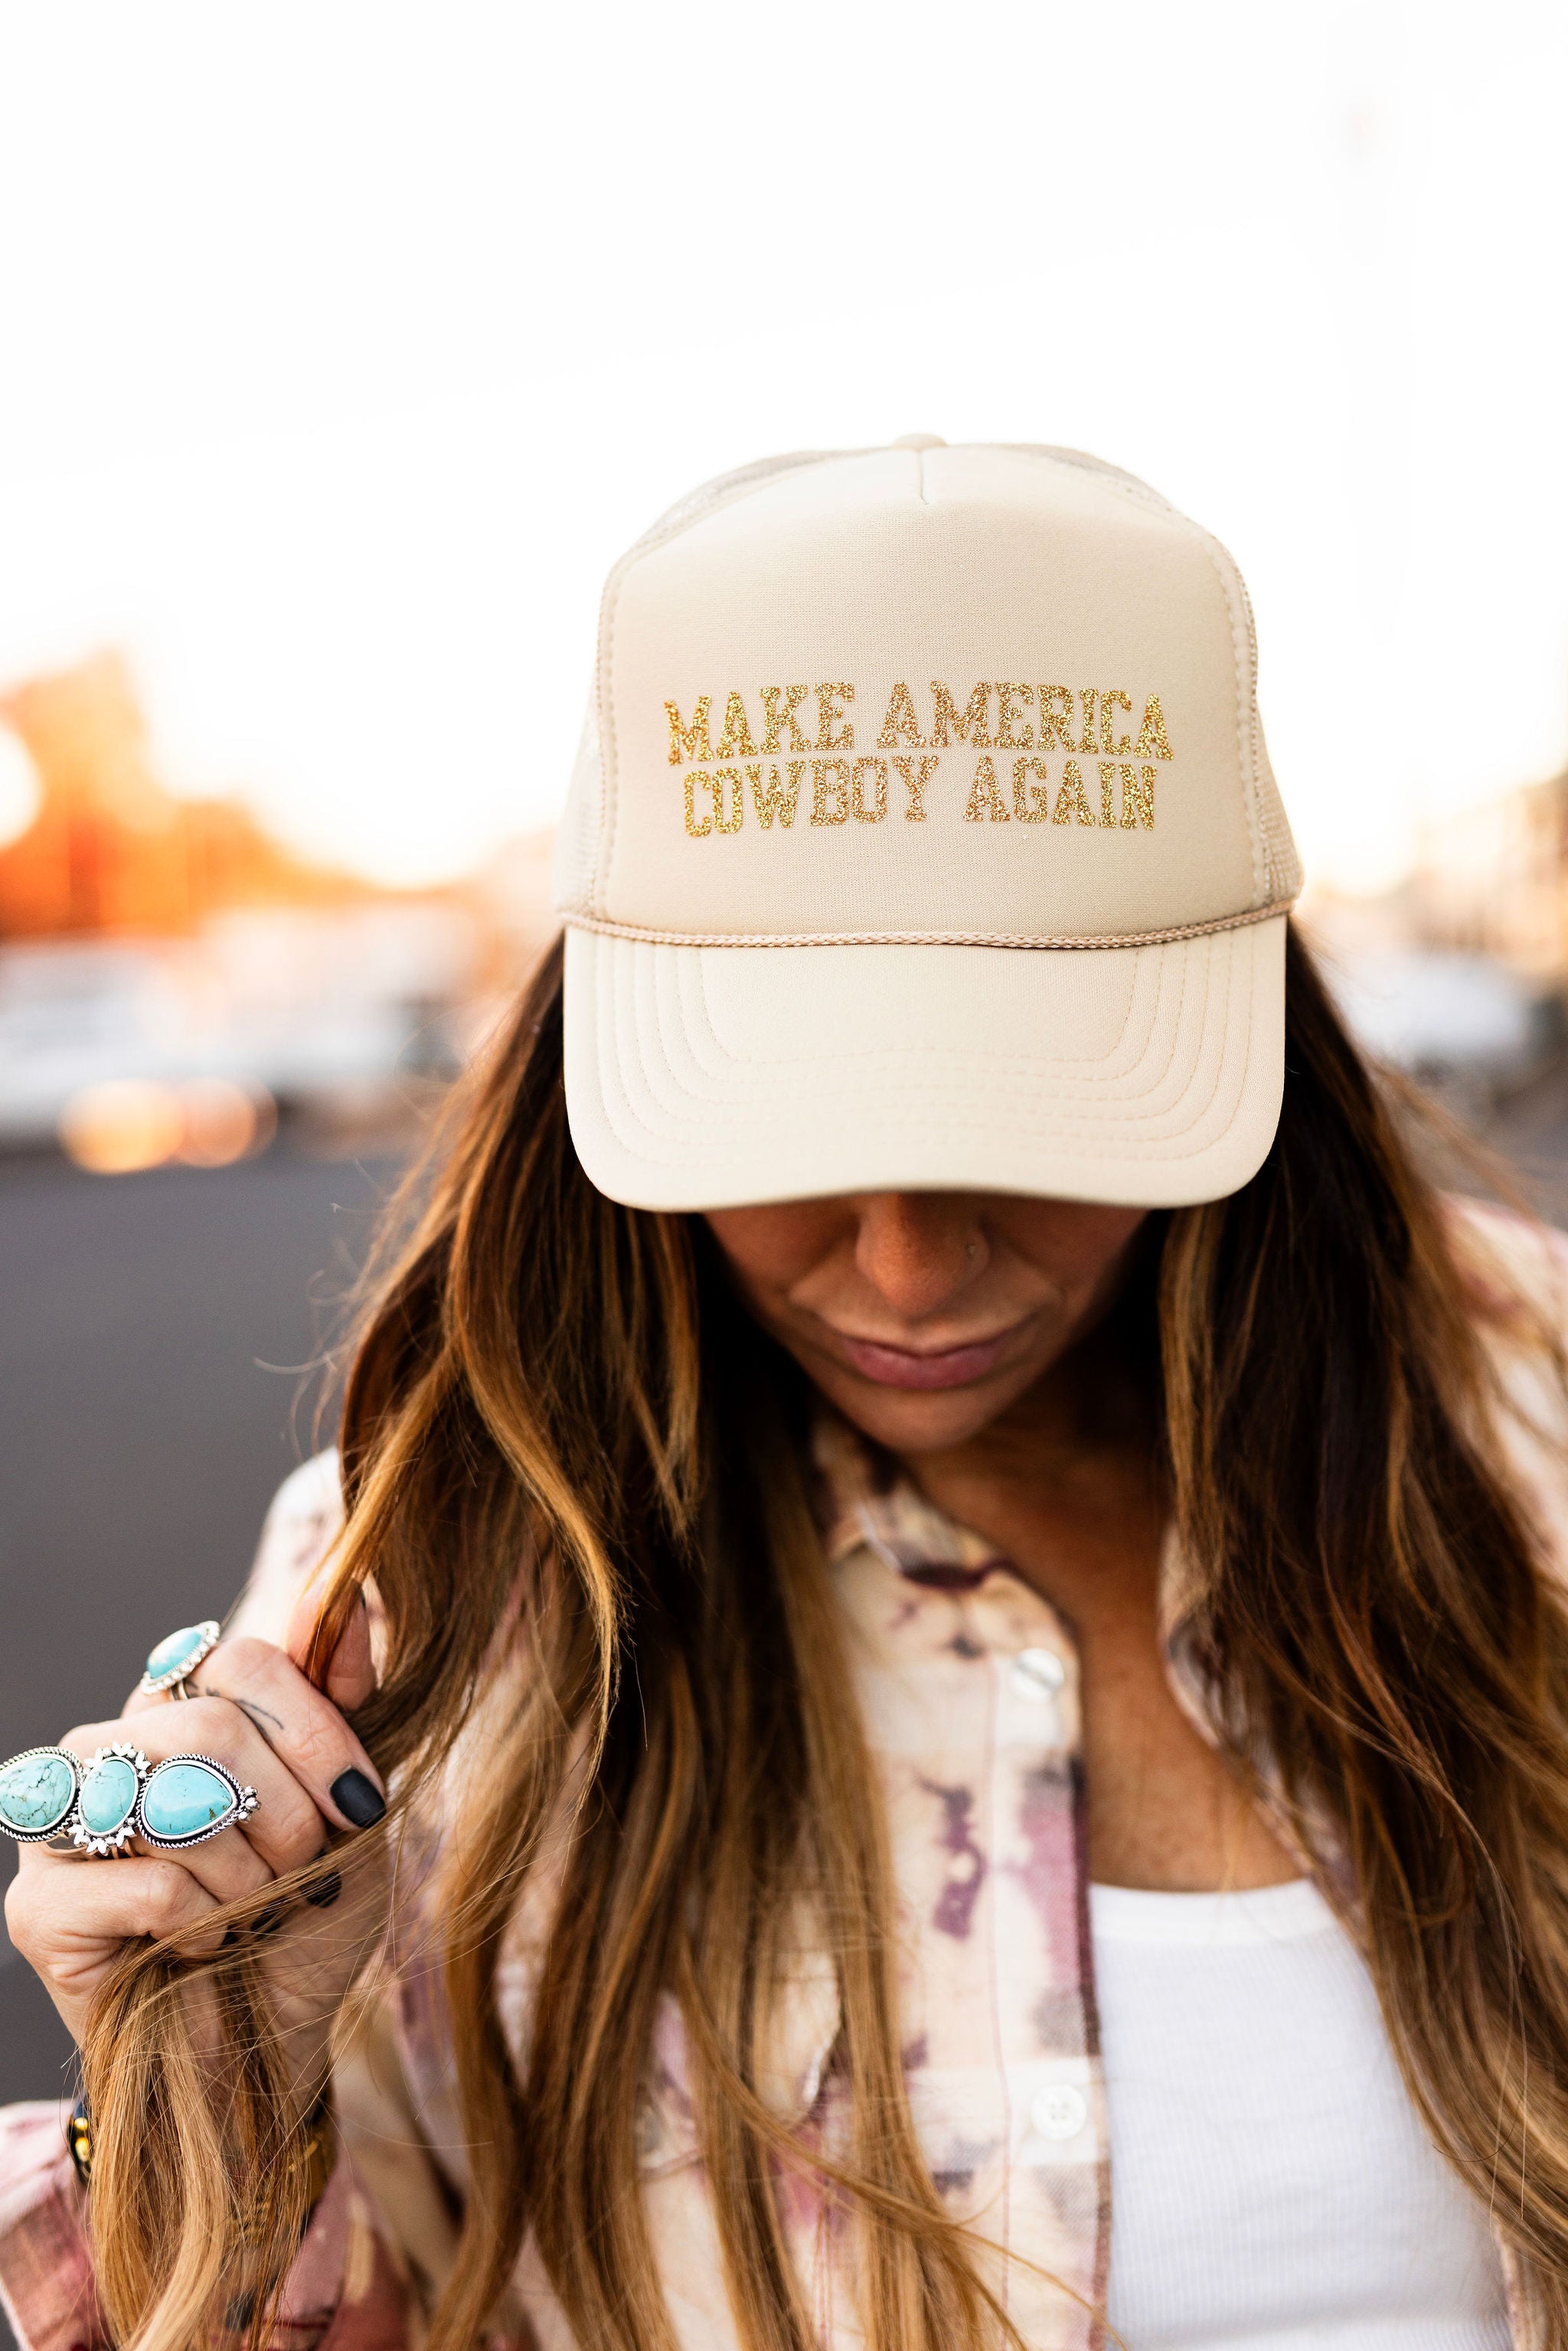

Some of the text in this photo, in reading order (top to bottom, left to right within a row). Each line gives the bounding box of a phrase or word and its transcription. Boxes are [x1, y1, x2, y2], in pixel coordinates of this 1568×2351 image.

[664, 681, 1174, 765] MAKE AMERICA
[684, 756, 1158, 837] COWBOY AGAIN
